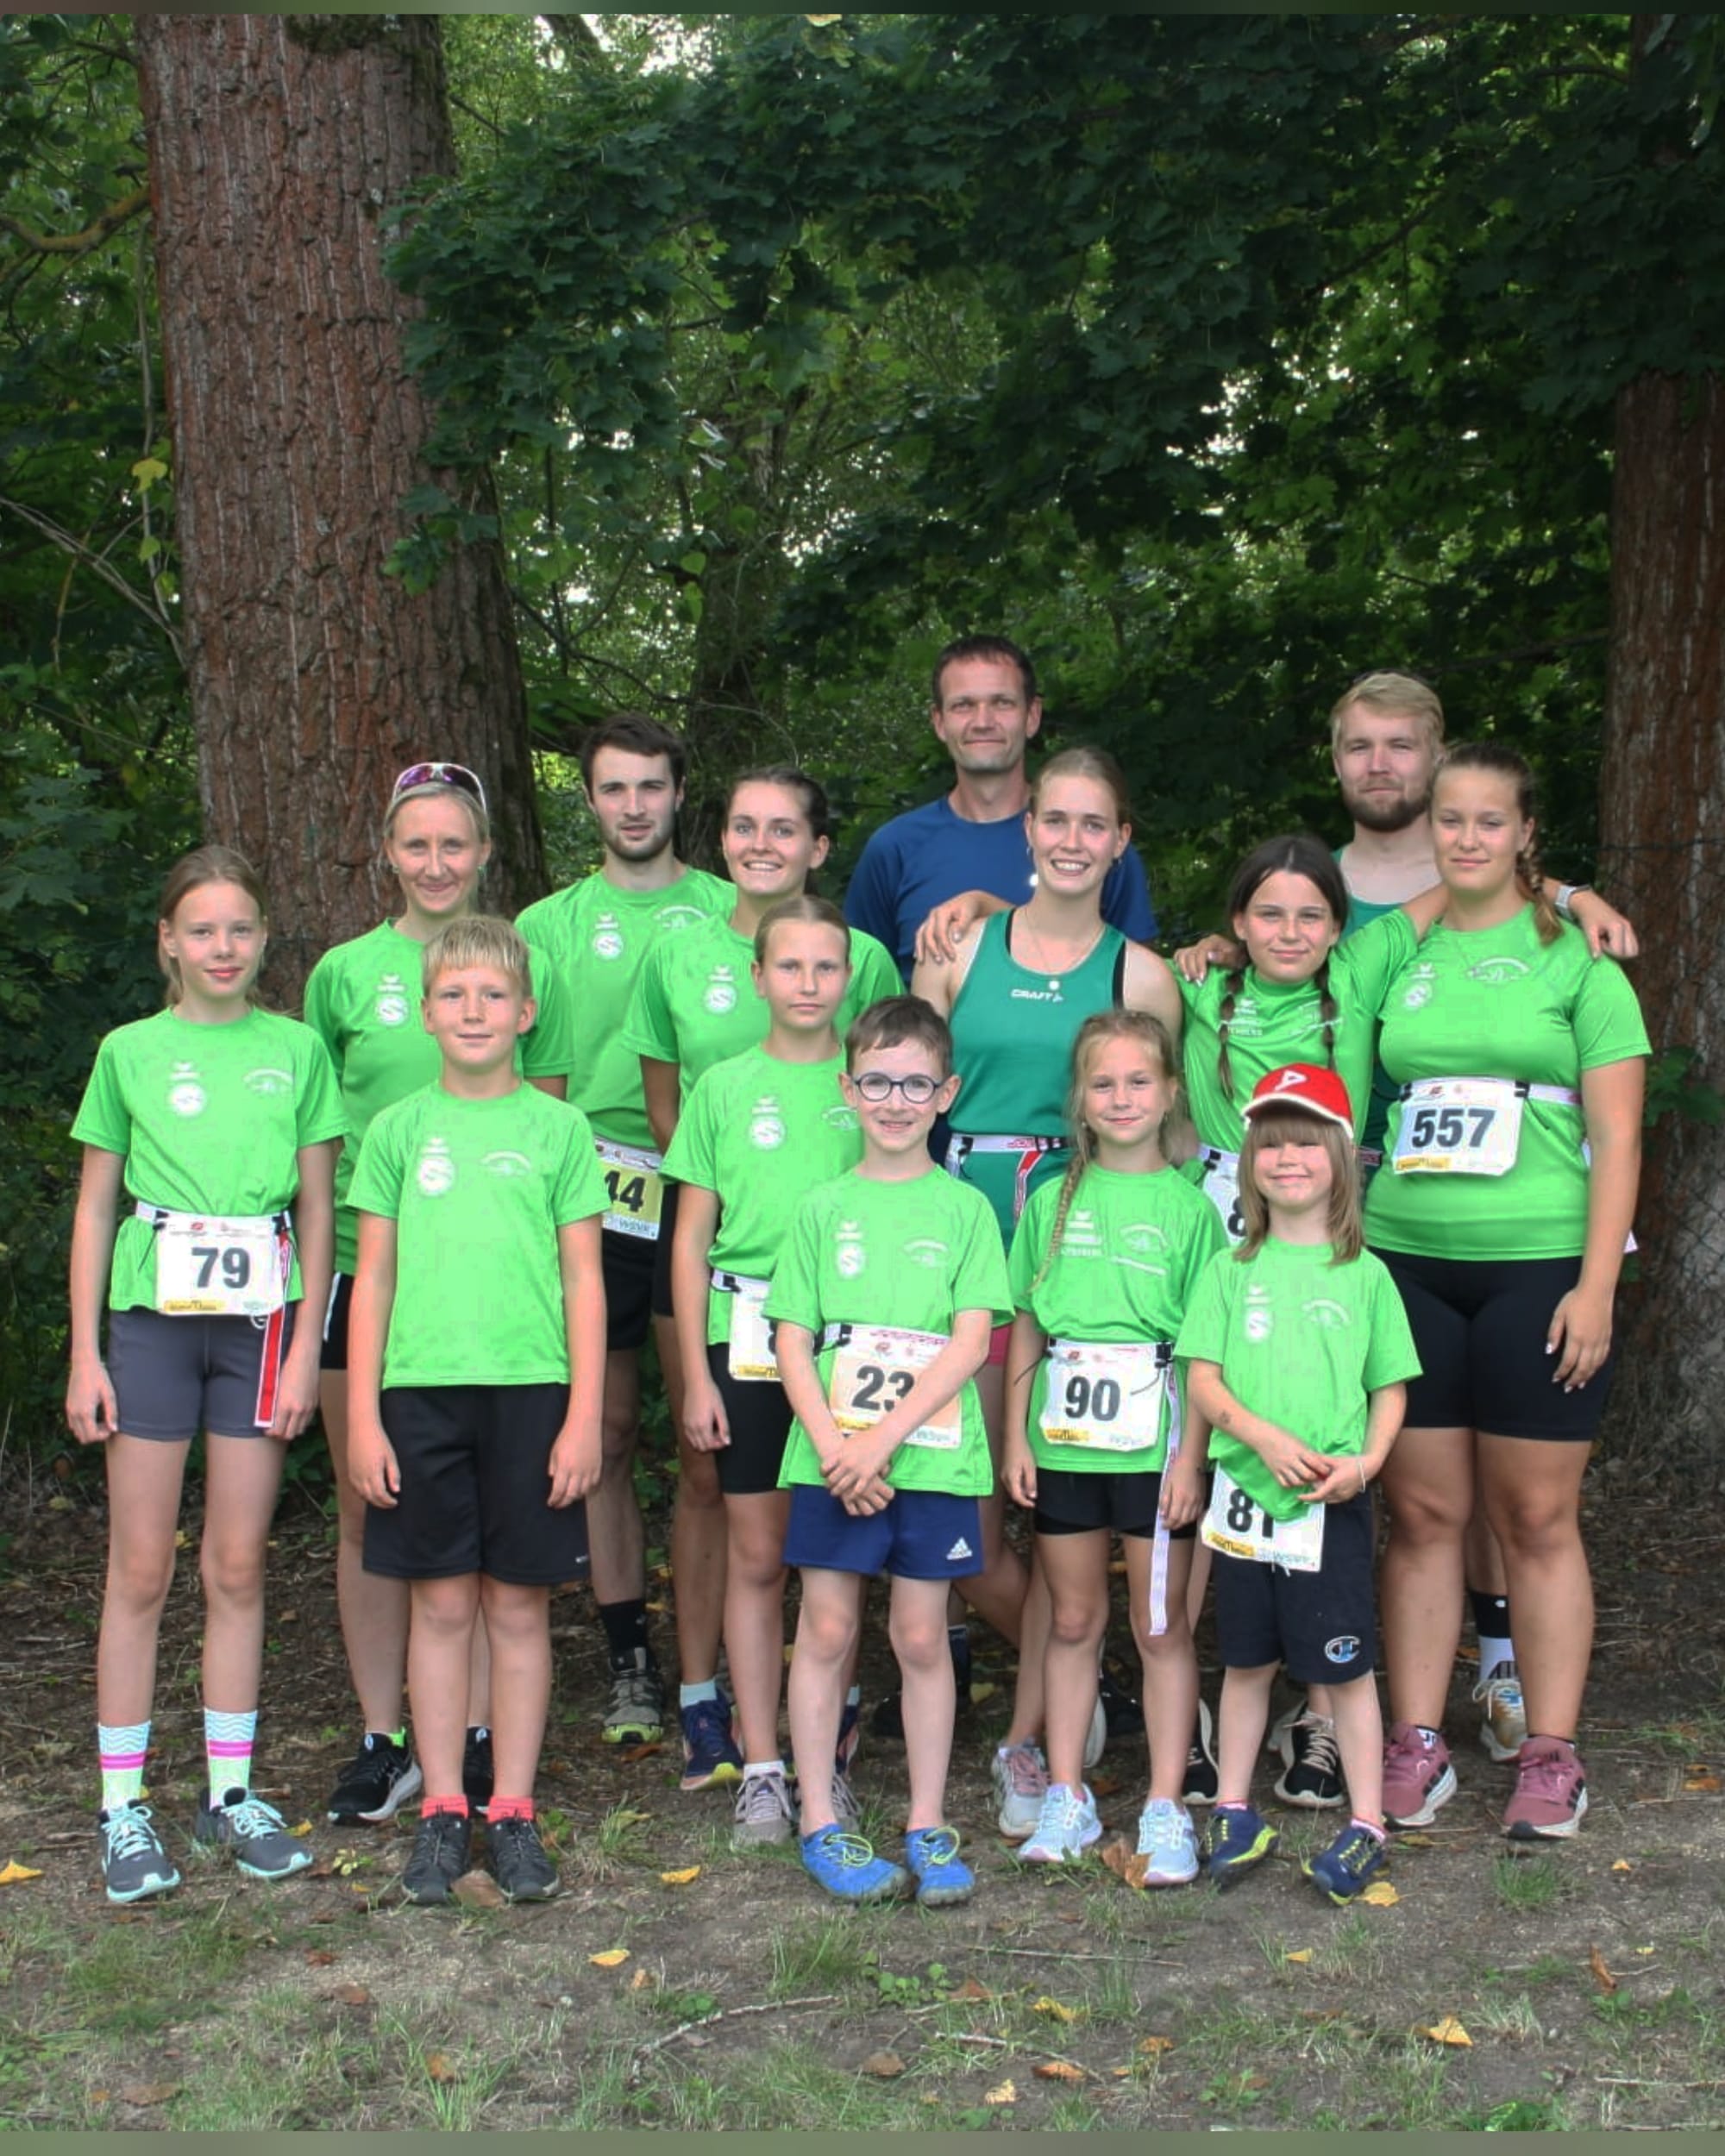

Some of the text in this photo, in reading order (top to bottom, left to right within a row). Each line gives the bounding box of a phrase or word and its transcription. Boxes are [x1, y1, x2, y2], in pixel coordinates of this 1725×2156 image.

[1274, 1069, 1308, 1091] P
[1411, 1108, 1496, 1148] 557
[191, 1246, 250, 1288] 79
[851, 1365, 915, 1412] 23
[1064, 1376, 1121, 1421] 90
